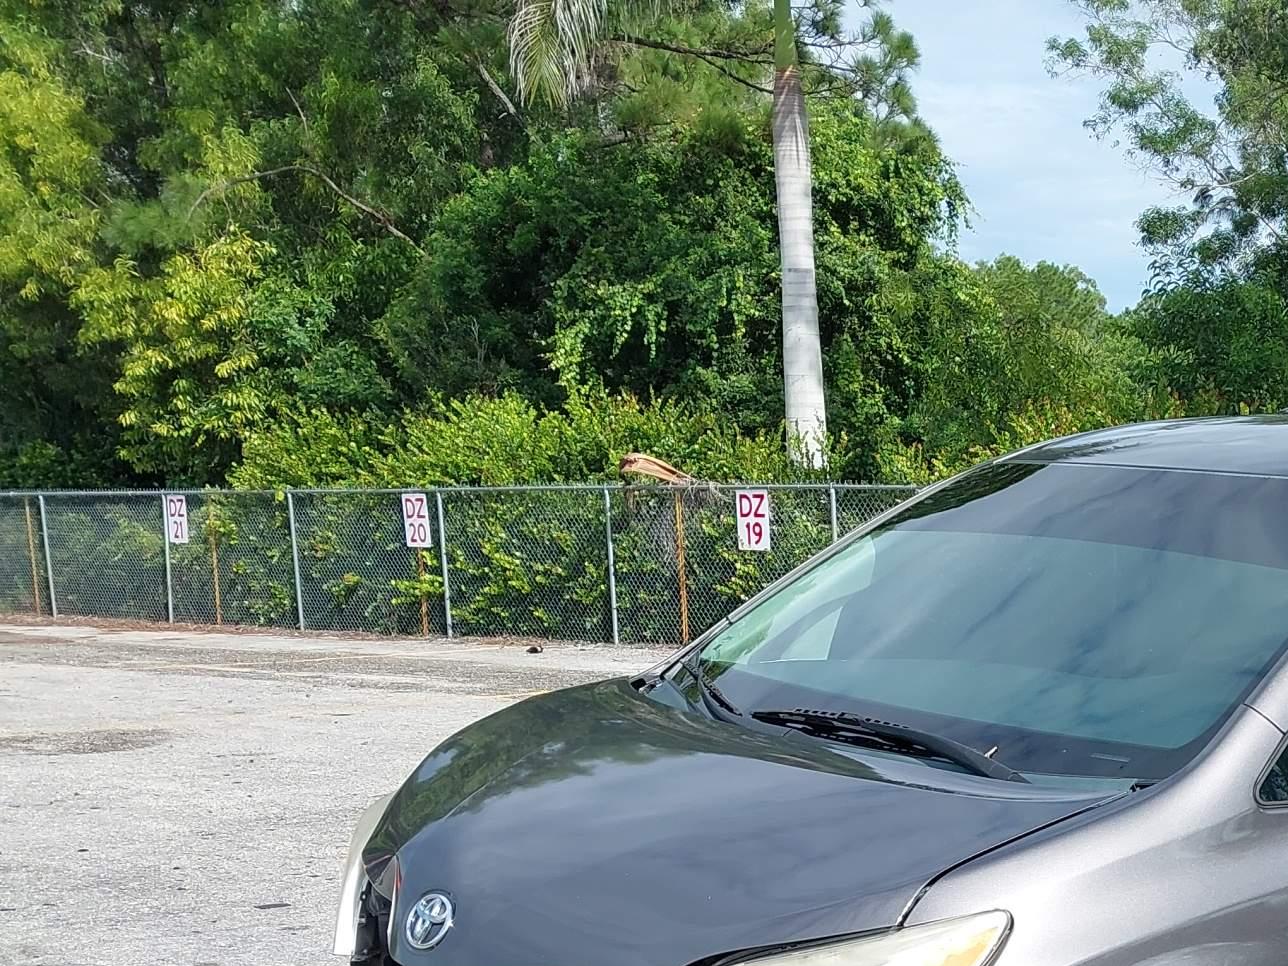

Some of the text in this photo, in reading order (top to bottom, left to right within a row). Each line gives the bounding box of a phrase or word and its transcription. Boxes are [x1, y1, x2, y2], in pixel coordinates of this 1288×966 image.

[169, 499, 184, 517] DZ
[405, 498, 426, 518] DZ
[739, 494, 766, 518] DZ
[174, 520, 183, 539] 21
[409, 522, 426, 543] 20
[745, 522, 763, 545] 19
